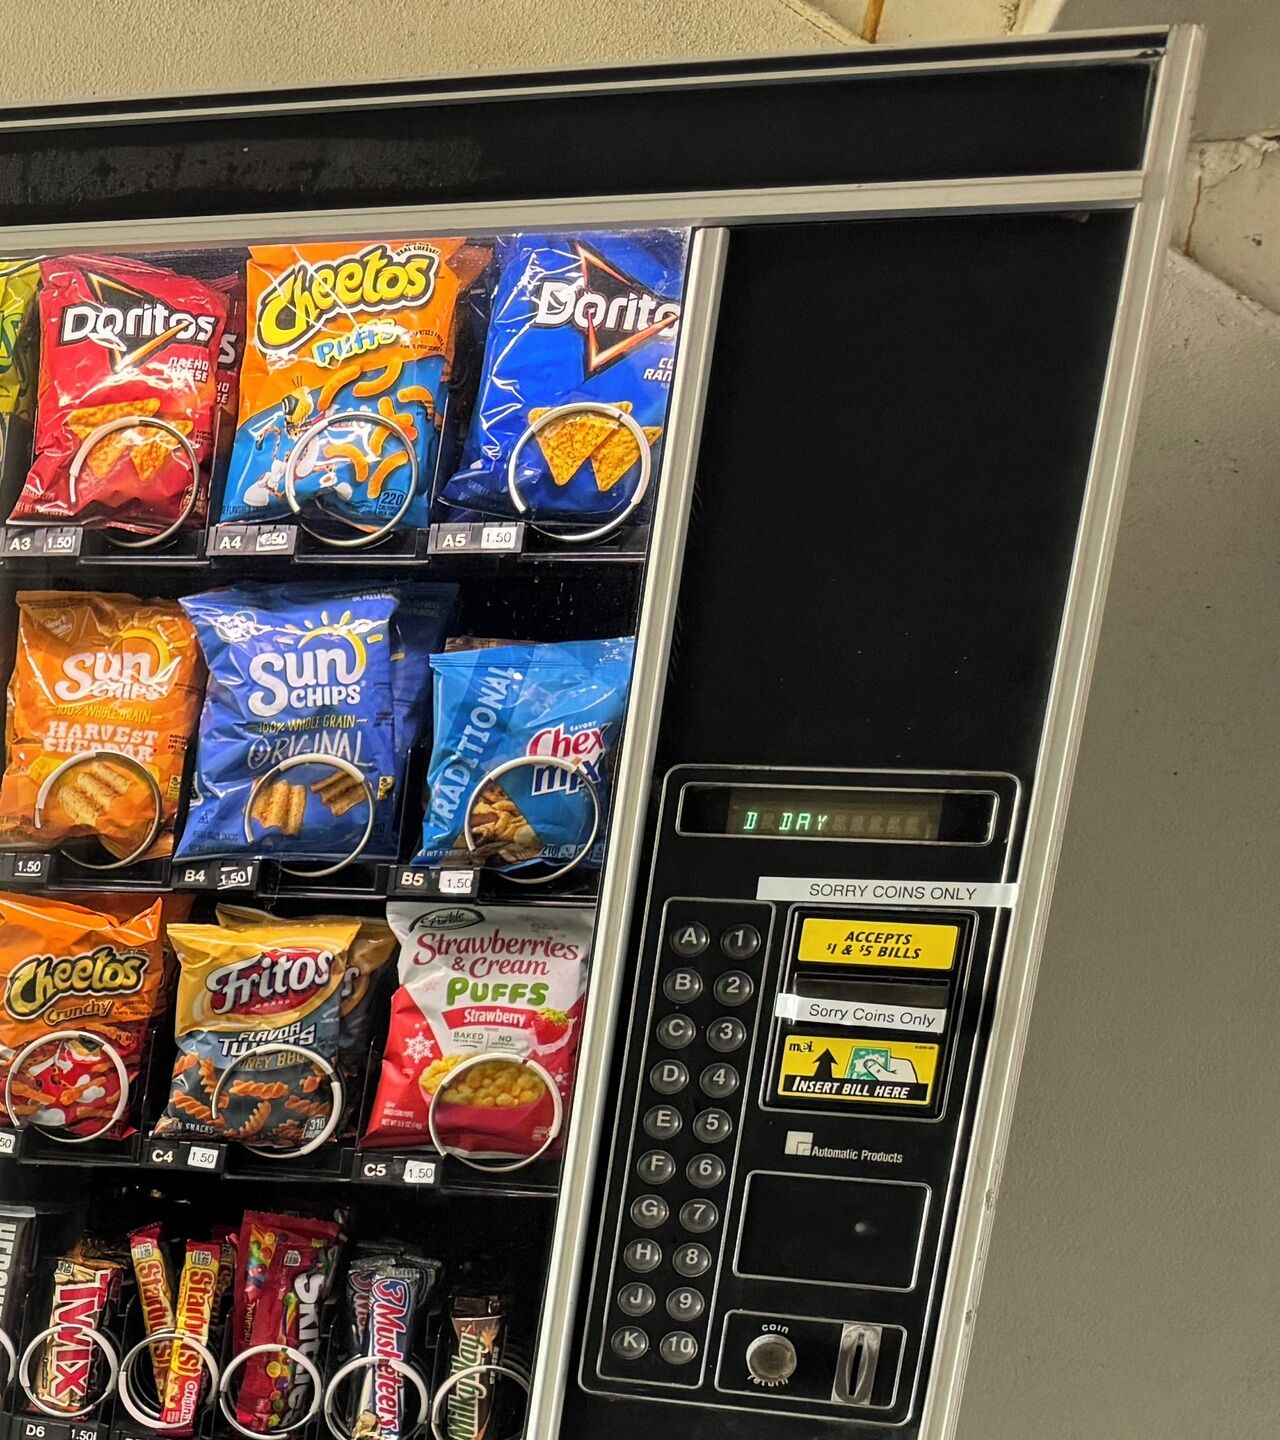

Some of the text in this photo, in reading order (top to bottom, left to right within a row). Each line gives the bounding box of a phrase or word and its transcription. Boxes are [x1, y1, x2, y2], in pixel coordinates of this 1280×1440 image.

[261, 248, 429, 346] Cheetos
[62, 304, 216, 342] Doritos
[381, 493, 402, 505] 220
[10, 539, 72, 552] A3 1.50
[219, 537, 241, 550] A4
[442, 531, 512, 548] A5 1.50
[55, 651, 156, 701] Sun
[248, 648, 366, 717] Sun
[290, 684, 360, 708] CHIPS
[288, 717, 320, 731] WHOLE
[323, 714, 356, 729] GRAIN
[48, 720, 159, 747] HARVEST
[528, 723, 606, 758] Chex
[43, 737, 154, 763] CHEDDAR
[247, 730, 374, 771] ORIGINAL
[779, 812, 828, 831] DAY
[17, 861, 41, 873] 1.50
[184, 870, 205, 882] B4
[402, 871, 425, 886] B5
[809, 883, 977, 901] SORRY COINS ONLY
[844, 931, 913, 945] ACCEPTS
[413, 929, 579, 966] Strawberries
[877, 946, 922, 960] BILLS
[451, 956, 550, 979] & Cream
[10, 948, 146, 1015] Cheetos
[206, 950, 335, 1015] Fritos
[446, 976, 550, 1006] PUFFS
[45, 999, 114, 1026] Crunchy
[464, 1008, 527, 1028] Strawberry
[809, 1003, 936, 1028] Sorry Coins Only
[238, 1021, 302, 1042] FLAVOR
[453, 1031, 484, 1040] BAKED
[791, 1075, 910, 1099] INSERT BILL HERE
[309, 1117, 325, 1129] 310
[152, 1149, 215, 1164] C4 1.50
[811, 1145, 903, 1164] Automatic Products
[363, 1163, 433, 1179] C5 1.50
[698, 1159, 712, 1176] 6
[641, 1199, 658, 1217] G
[693, 1204, 707, 1221] 7
[635, 1243, 652, 1260] H
[685, 1248, 699, 1265] 8
[372, 1278, 407, 1304] 3
[629, 1287, 643, 1305] J
[679, 1292, 692, 1310] 9
[54, 1271, 111, 1398] TWIX
[761, 1323, 789, 1335] coin
[622, 1332, 639, 1348] K
[669, 1336, 692, 1354] 10
[746, 1374, 789, 1387] return
[25, 1424, 45, 1437] D6
